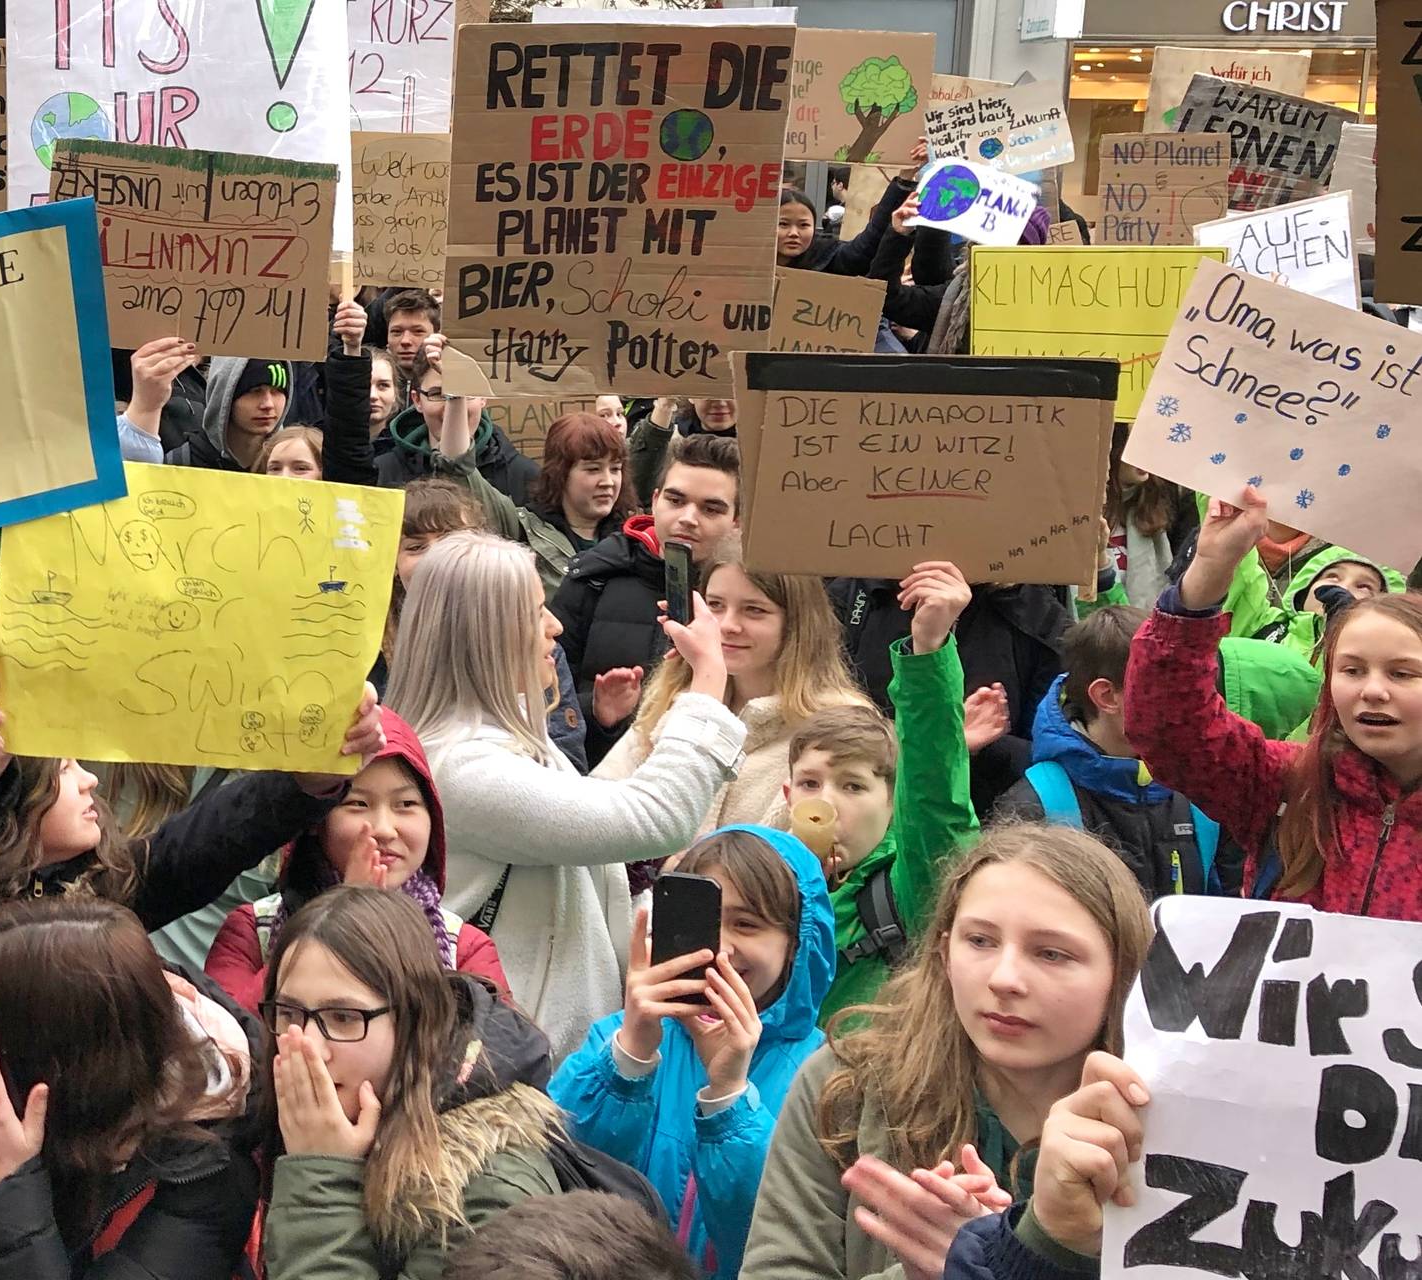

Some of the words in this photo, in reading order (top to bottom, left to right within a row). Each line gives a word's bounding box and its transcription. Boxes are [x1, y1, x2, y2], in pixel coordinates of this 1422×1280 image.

[370, 0, 454, 44] KURZ
[1221, 0, 1349, 33] CHRIST
[486, 42, 682, 109] RETTET
[703, 42, 791, 111] DIE
[925, 109, 944, 124] Wir
[948, 102, 975, 119] sind
[978, 96, 1008, 111] hier,
[951, 113, 976, 130] sind
[1213, 85, 1329, 132] WARUM
[530, 110, 653, 161] ERDE
[1113, 141, 1145, 165] NO
[1154, 139, 1223, 167] Planet
[361, 146, 416, 178] Welt
[171, 183, 209, 206] wir
[222, 181, 321, 225] Erleben
[475, 162, 516, 202] ES
[525, 162, 582, 202] IST
[588, 163, 651, 203] DER
[656, 163, 781, 213] EINZIGE
[1106, 183, 1148, 212] NO
[384, 211, 426, 233] grün
[496, 208, 627, 257] PLANET
[642, 208, 717, 256] MIT
[1230, 231, 1349, 275] ACHEN
[119, 286, 182, 317] eure
[458, 260, 555, 319] BIER,
[561, 256, 709, 322] Schoki
[723, 303, 772, 332] UND
[974, 263, 1199, 310] KLIMASCHUT
[255, 287, 306, 349] Ihr
[792, 298, 865, 338] zum
[483, 327, 590, 383] Harry
[605, 320, 720, 387] Potter
[1290, 329, 1363, 371] was
[1371, 344, 1422, 396] ist
[778, 396, 838, 427] DIE
[859, 400, 1067, 428] KLIMAPOLITIK
[793, 435, 840, 458] IST
[858, 433, 921, 453] EIN
[936, 434, 1016, 463] WITZ!
[781, 470, 849, 492] Aber
[872, 465, 993, 494] KEINER
[828, 519, 934, 548] LACHT
[989, 561, 1004, 572] HA
[1008, 546, 1024, 558] HA
[1030, 535, 1048, 547] HA
[1050, 524, 1068, 536] HA
[1072, 514, 1090, 526] HA
[1140, 902, 1370, 1057] Wir
